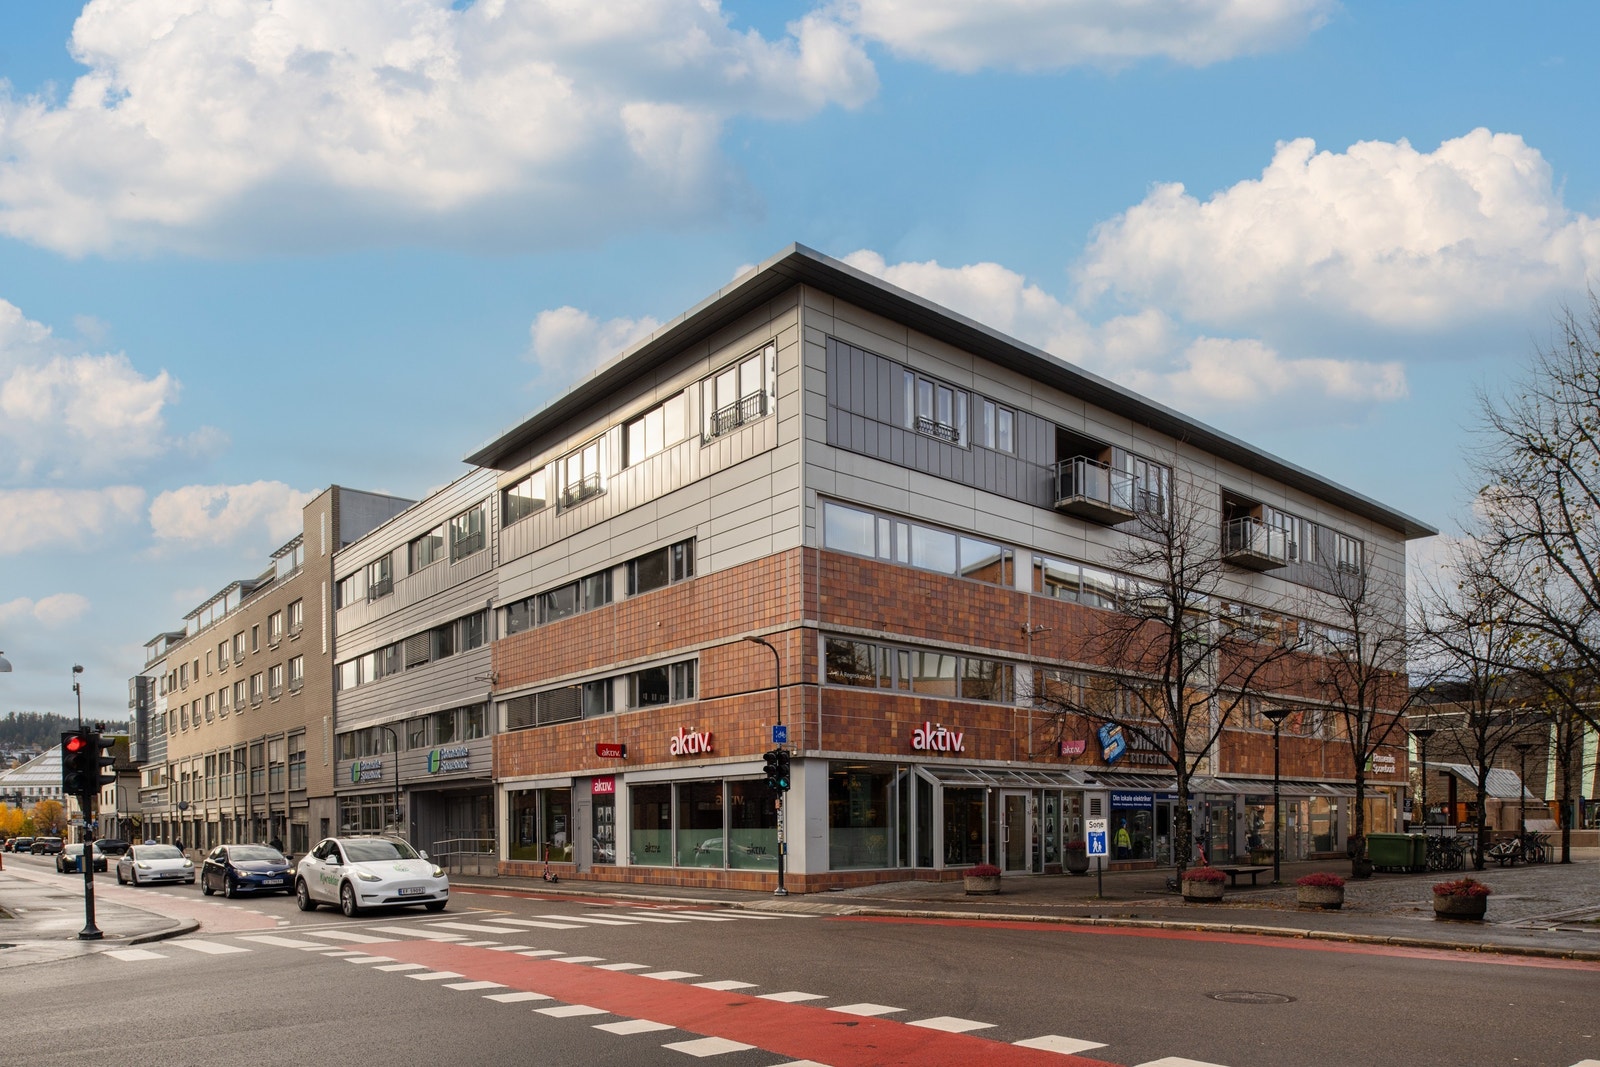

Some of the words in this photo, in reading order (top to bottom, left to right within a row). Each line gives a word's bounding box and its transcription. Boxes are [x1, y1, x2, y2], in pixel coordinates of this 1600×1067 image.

[670, 726, 712, 756] aktiv.
[911, 721, 966, 752] aktiv.
[601, 748, 621, 757] aktiv.
[594, 778, 613, 792] aktiv.
[1120, 794, 1133, 802] lokale
[1089, 821, 1104, 829] Sone
